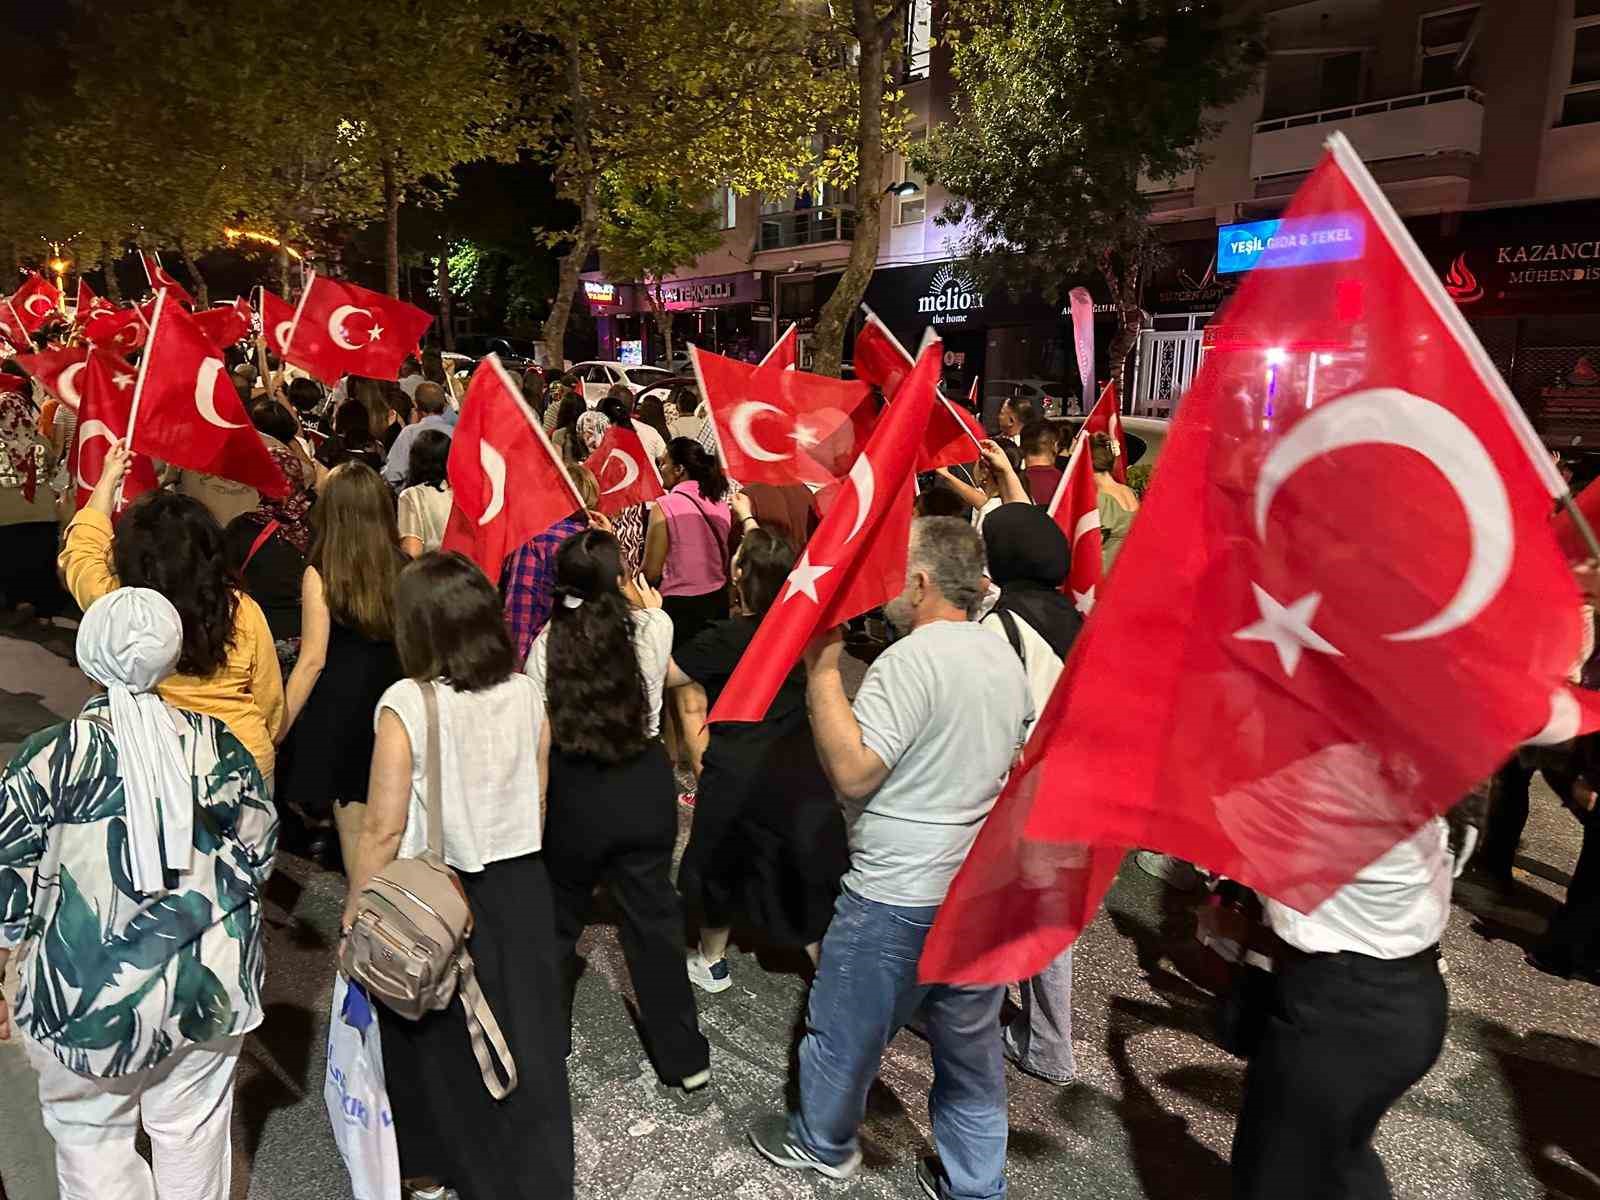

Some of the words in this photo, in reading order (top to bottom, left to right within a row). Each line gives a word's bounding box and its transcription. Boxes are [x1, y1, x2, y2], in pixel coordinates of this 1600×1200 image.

[1231, 236, 1264, 255] YEŞİL
[1311, 228, 1353, 245] TEKEL
[932, 313, 945, 325] the
[946, 312, 968, 324] home
